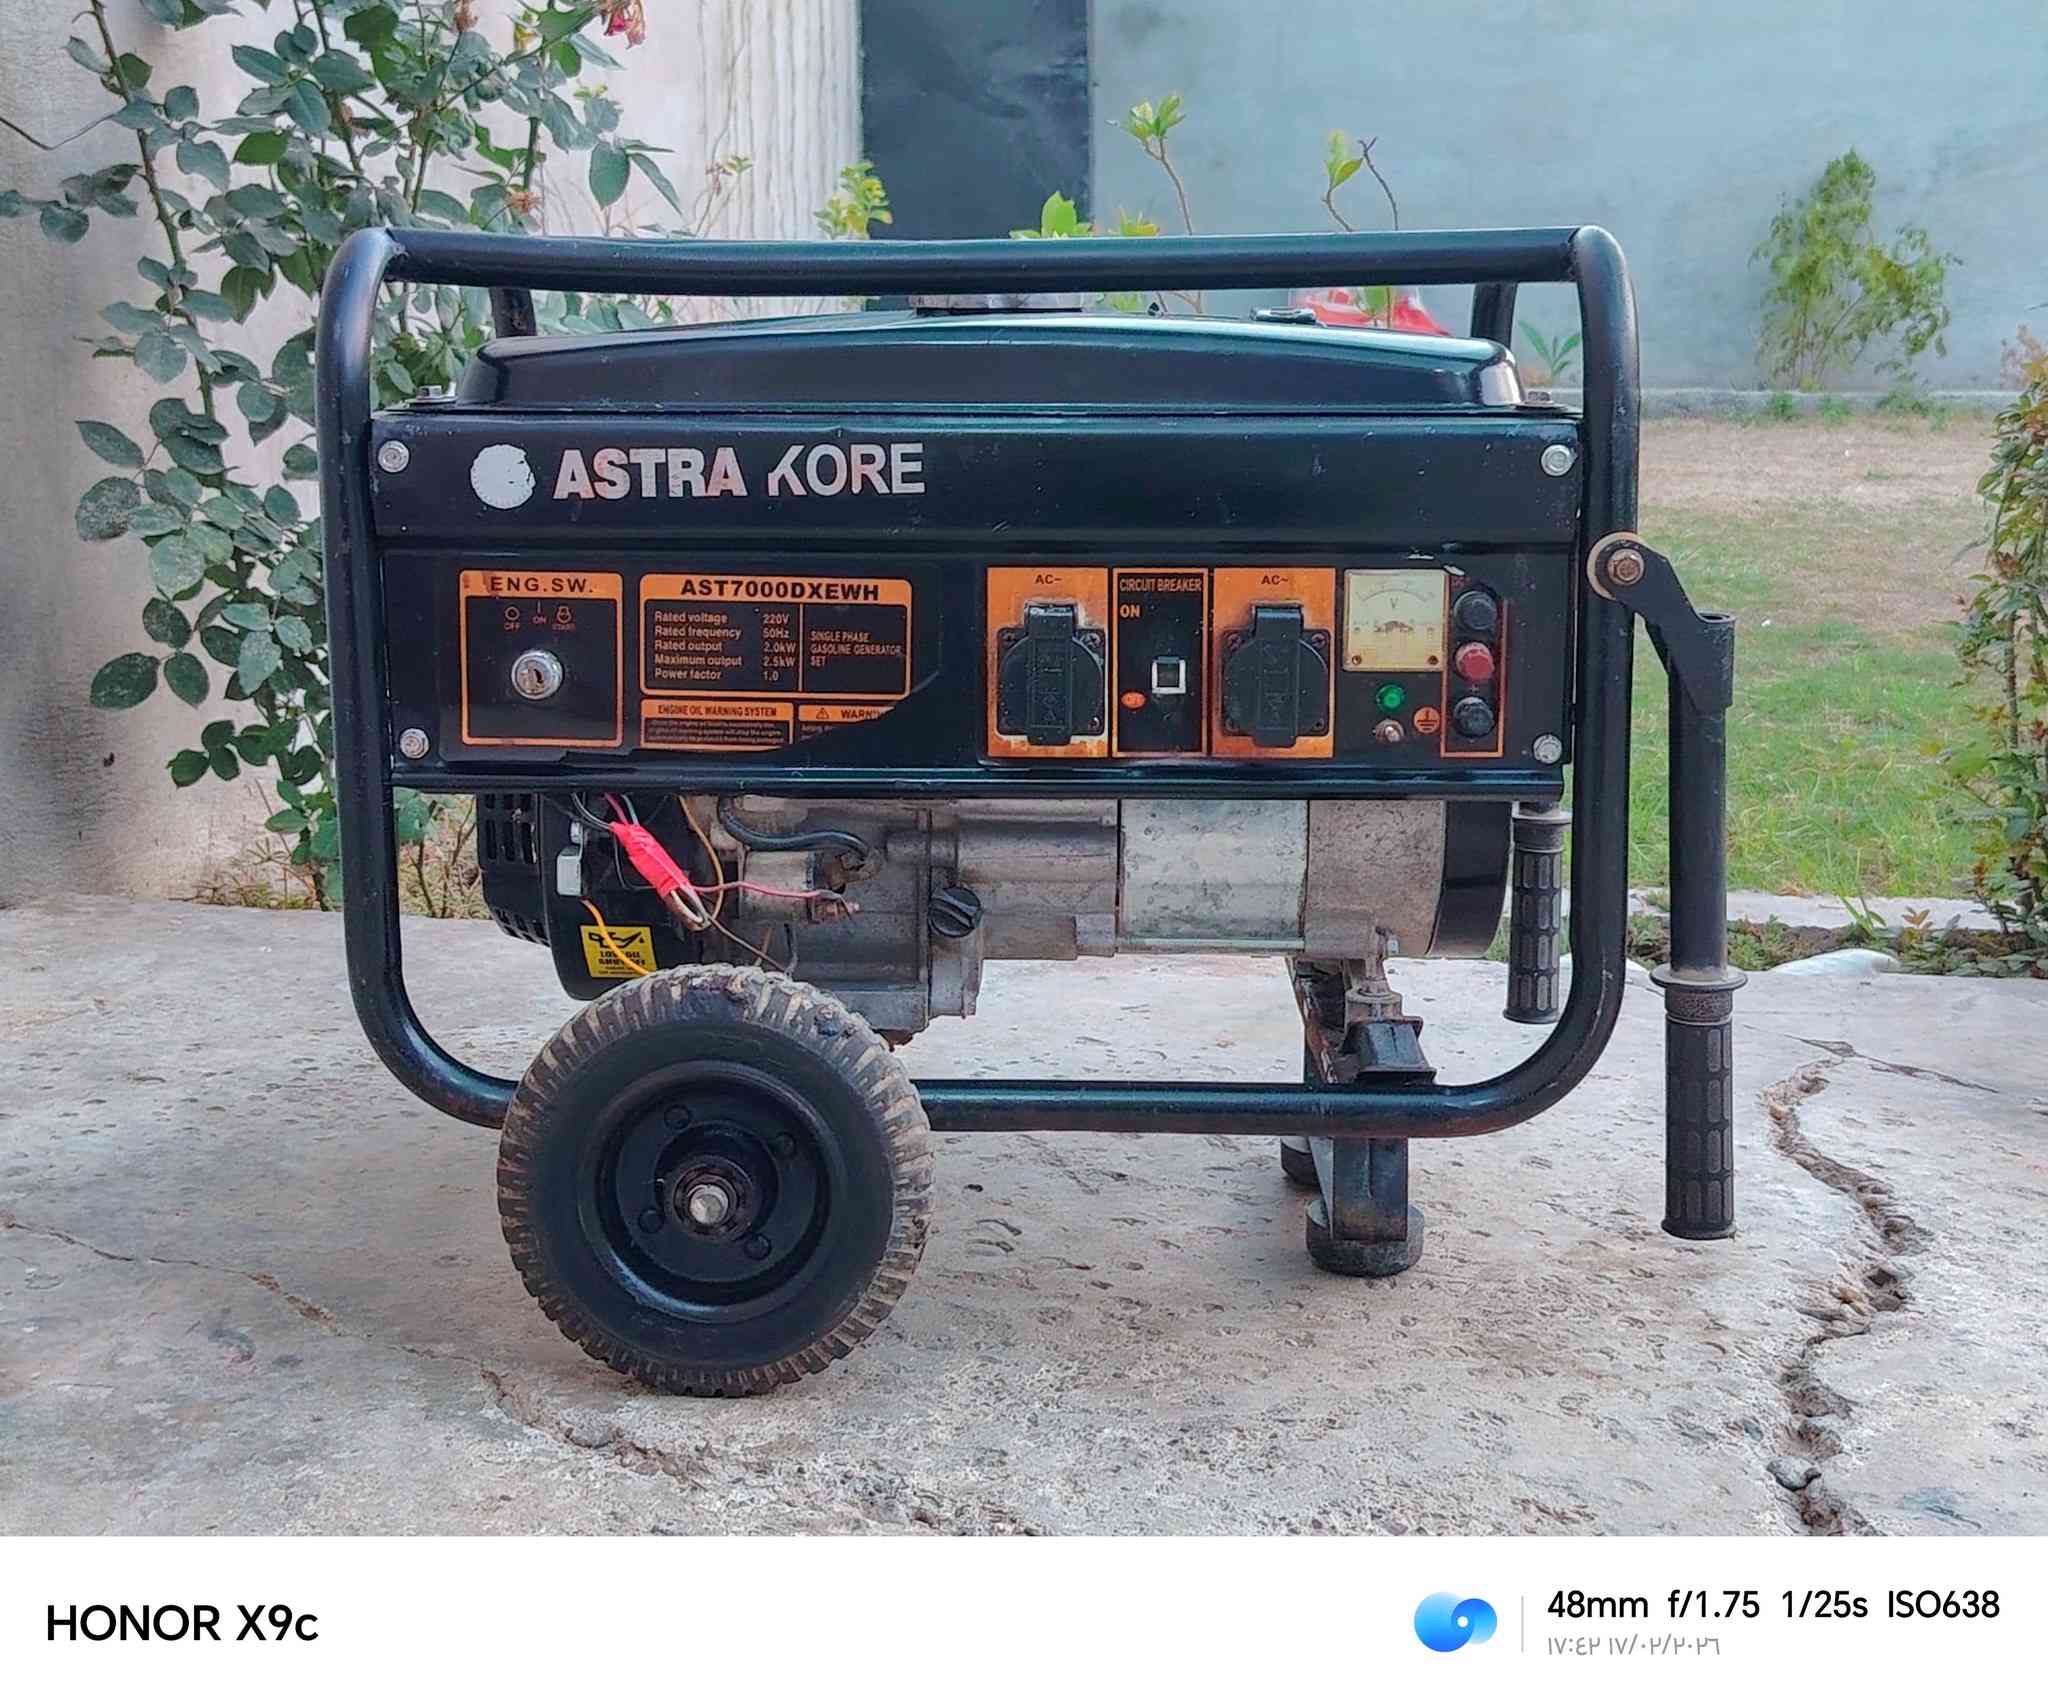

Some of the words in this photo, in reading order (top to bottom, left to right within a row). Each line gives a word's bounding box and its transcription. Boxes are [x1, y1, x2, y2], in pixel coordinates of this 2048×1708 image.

[552, 447, 748, 500] ASTRA
[767, 442, 926, 497] KORE
[490, 576, 593, 593] ENG.SW.
[680, 579, 879, 601] AST7000DXEWH
[1119, 577, 1155, 593] CIRCUIT
[1157, 577, 1202, 593] BREAKER
[655, 610, 686, 622] Rated
[688, 611, 728, 626] voltage
[762, 613, 790, 625] 220V
[1119, 604, 1141, 619] ON
[655, 625, 686, 637] Rated
[688, 626, 742, 641] frequency
[762, 627, 790, 639] 50Hz
[810, 630, 840, 642] SINGLE
[842, 631, 869, 643] PHASE
[655, 639, 686, 651] Rated
[688, 640, 722, 655] output
[763, 641, 796, 653] 2.0kW
[810, 644, 852, 655] GASOLINE
[853, 644, 903, 657] GENERATOR
[655, 653, 706, 665] Maximum
[707, 654, 742, 669] output
[763, 655, 796, 668] 2.5kW
[810, 656, 826, 667] SET
[655, 667, 688, 679] Power
[689, 668, 722, 680] factor
[763, 670, 779, 681] 1.0
[658, 703, 689, 715] ENGINE
[690, 704, 704, 716] OIL
[705, 705, 744, 717] WARNING
[745, 706, 777, 717] SYSTEM
